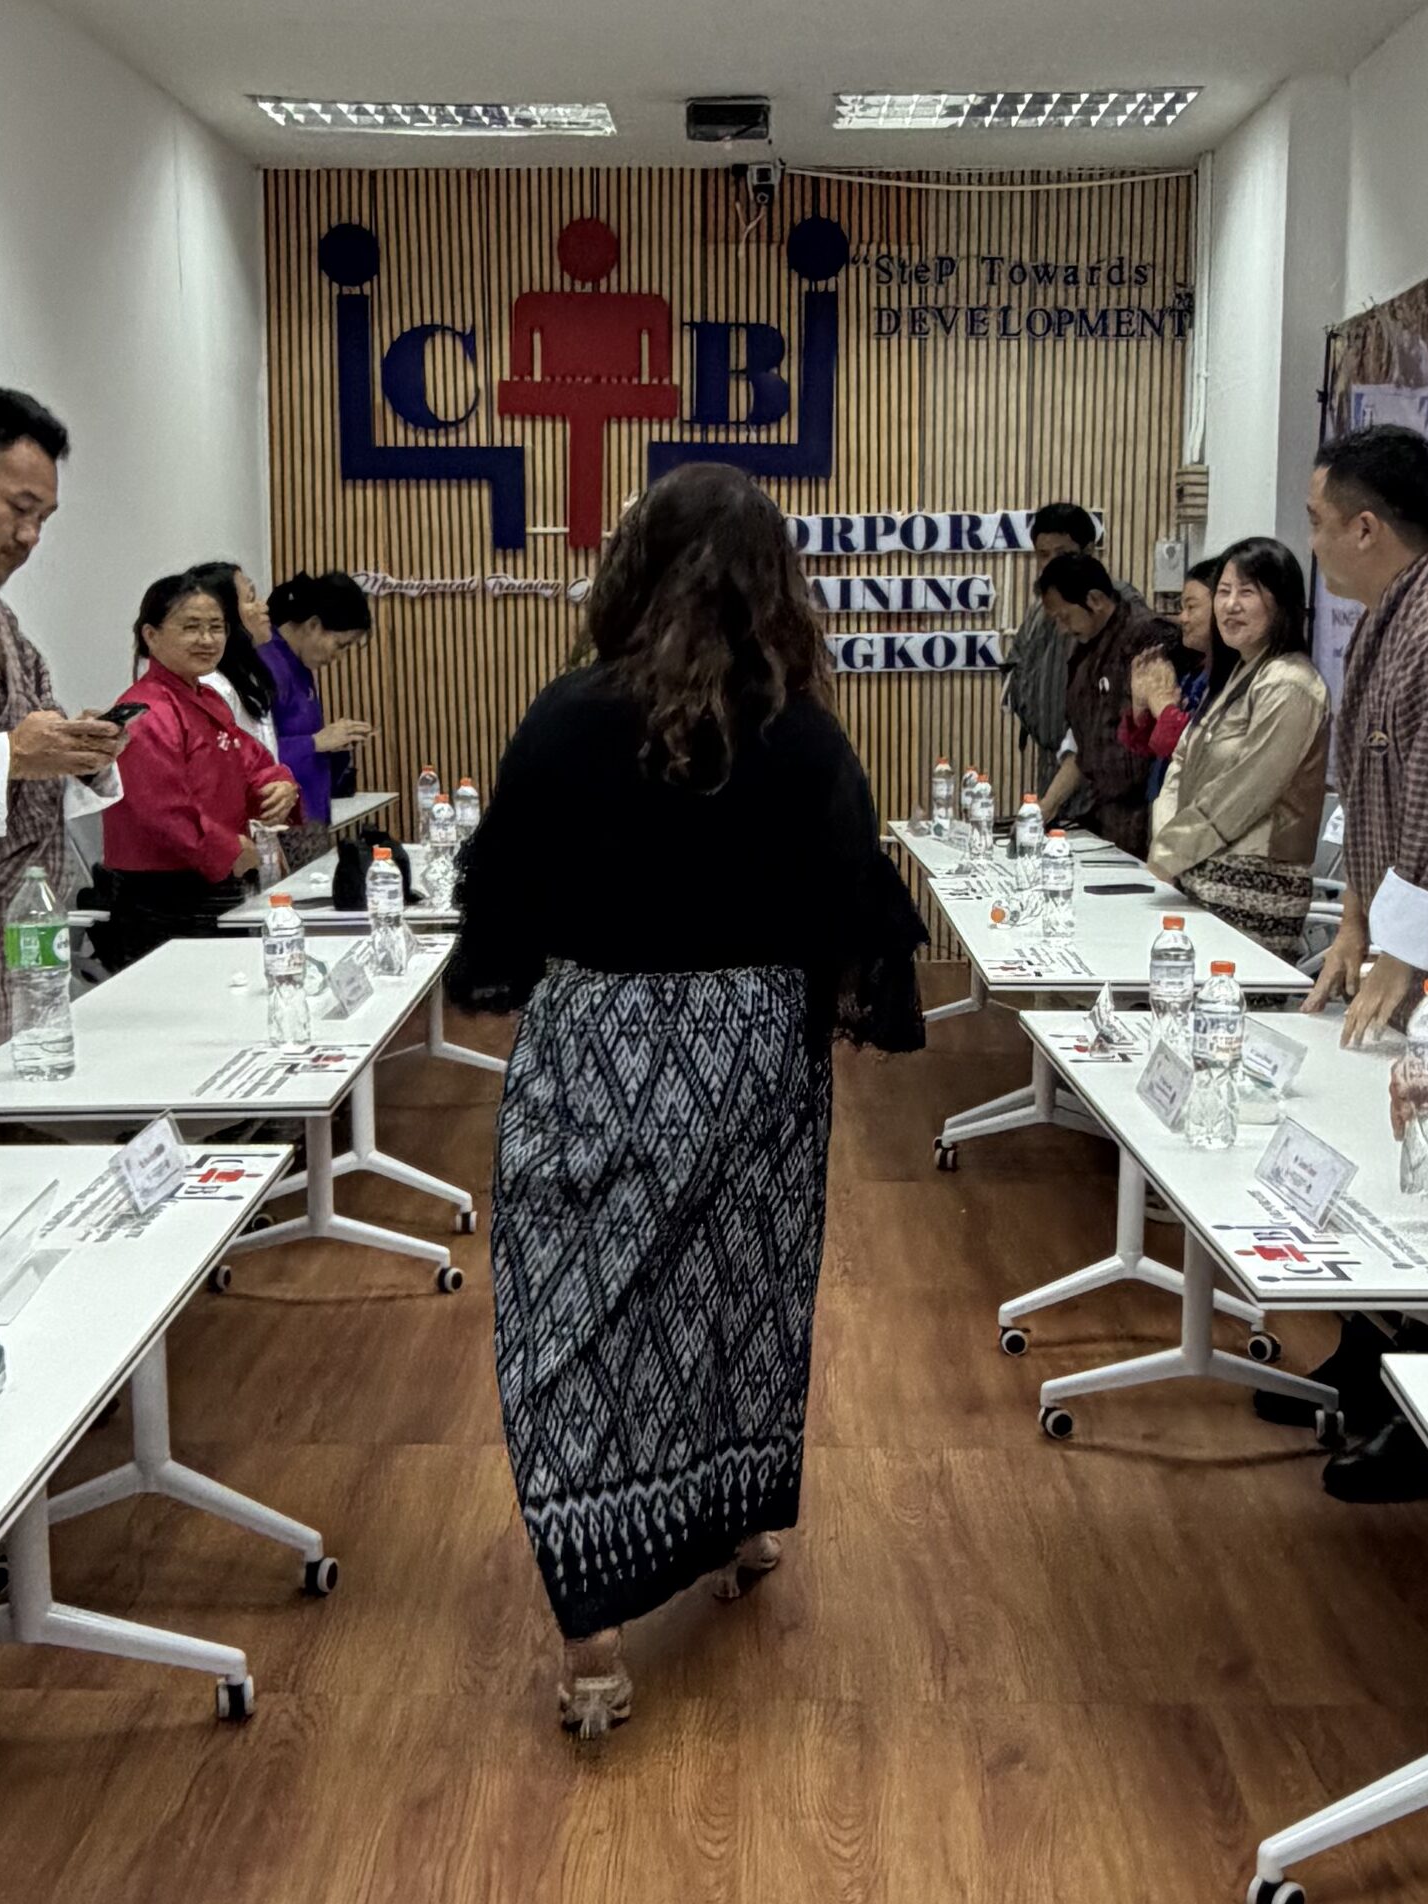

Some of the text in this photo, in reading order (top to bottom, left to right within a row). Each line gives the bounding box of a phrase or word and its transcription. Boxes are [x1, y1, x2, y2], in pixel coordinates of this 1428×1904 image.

[981, 256, 1151, 288] Towards
[485, 575, 564, 596] Training
[810, 577, 993, 611] AINING
